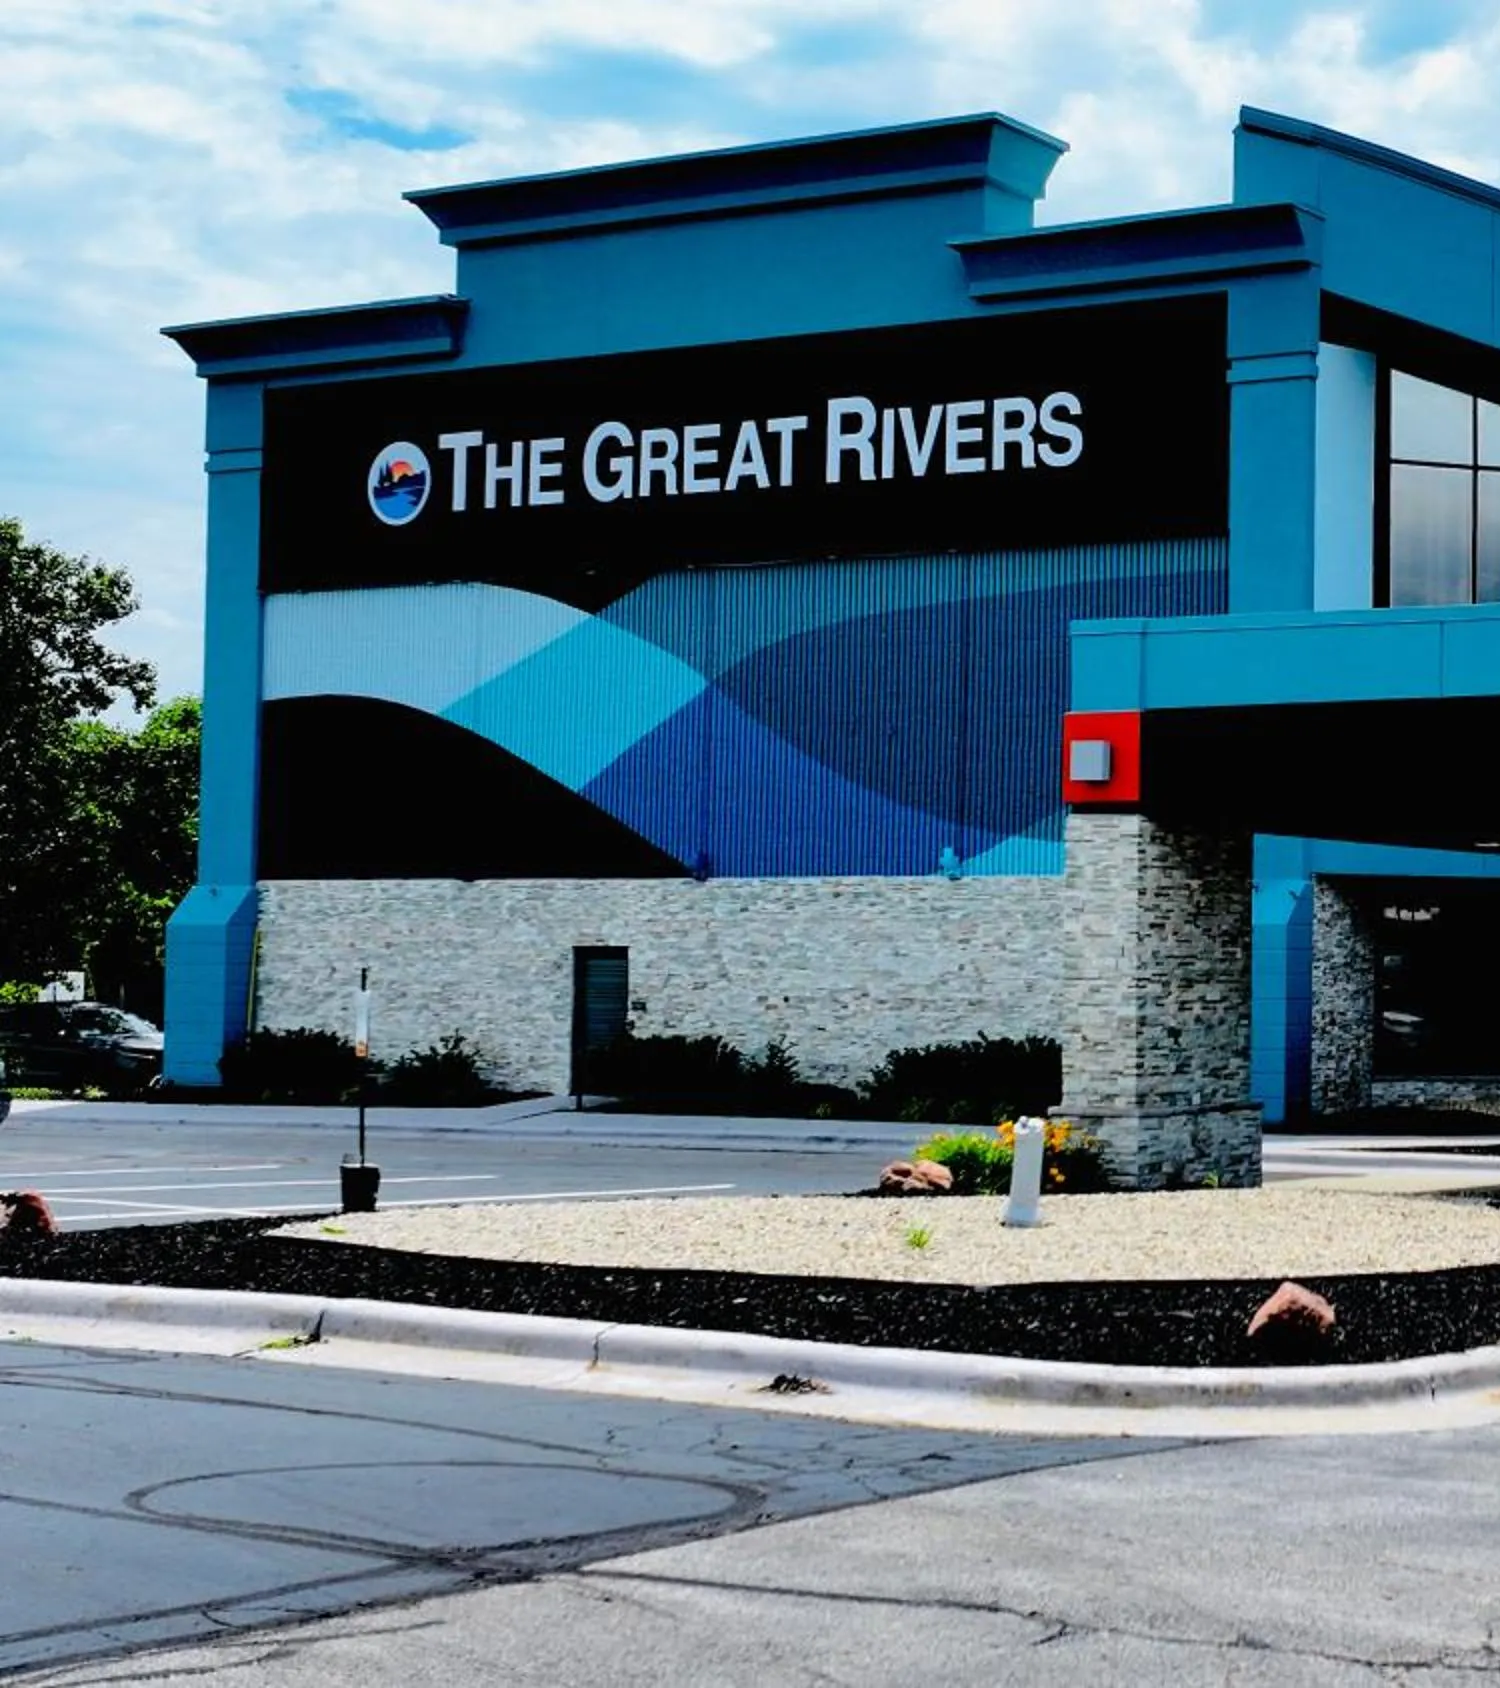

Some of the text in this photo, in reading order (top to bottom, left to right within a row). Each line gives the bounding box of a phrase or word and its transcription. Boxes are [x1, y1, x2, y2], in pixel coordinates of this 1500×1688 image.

[439, 391, 1083, 512] THE GREAT RIVERS
